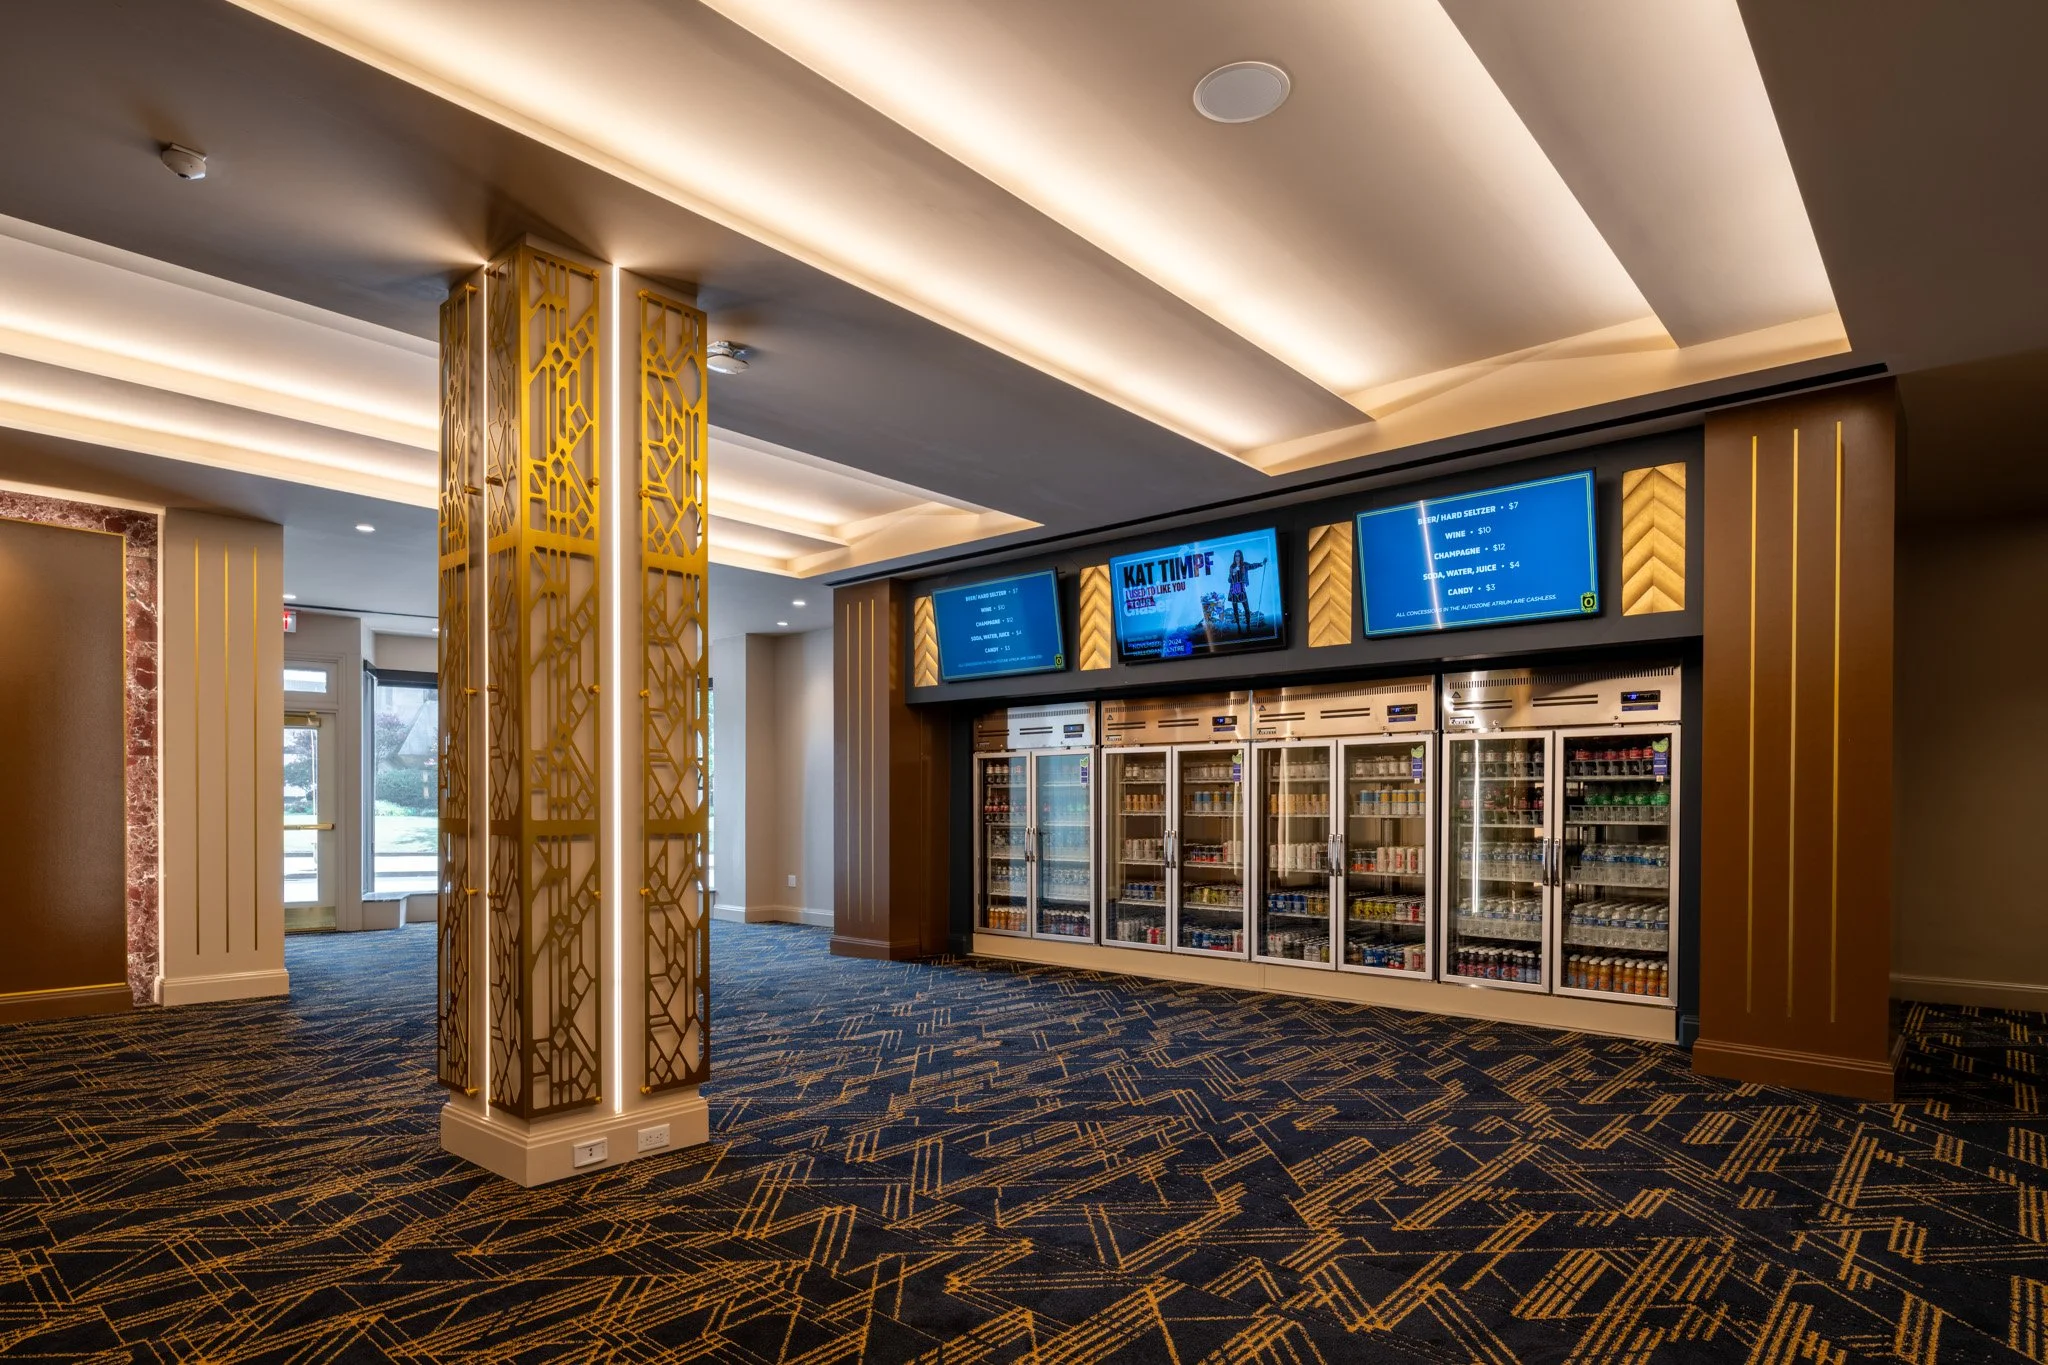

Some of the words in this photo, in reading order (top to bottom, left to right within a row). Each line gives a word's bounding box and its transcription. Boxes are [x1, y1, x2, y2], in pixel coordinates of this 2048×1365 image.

[1417, 514, 1440, 525] BEER/
[1440, 512, 1463, 522] HARD
[1463, 506, 1496, 518] SELTZER
[1508, 501, 1519, 511] $7
[1445, 530, 1466, 540] WINE
[1477, 526, 1492, 535] $10
[1434, 547, 1481, 560] CHAMPAGNE
[1492, 543, 1506, 552] $12
[1123, 562, 1155, 588] KAT
[1158, 551, 1214, 582] TIMPF
[1422, 572, 1446, 581] SODA,
[1446, 567, 1475, 578] WATER,
[1475, 563, 1497, 574] JUICE
[1509, 561, 1520, 569] $4
[1156, 583, 1172, 595] LIKE
[1172, 581, 1186, 592] YOU
[1447, 586, 1474, 596] CANDY
[1485, 583, 1496, 592] $3
[1491, 599, 1513, 607] ATRIUM
